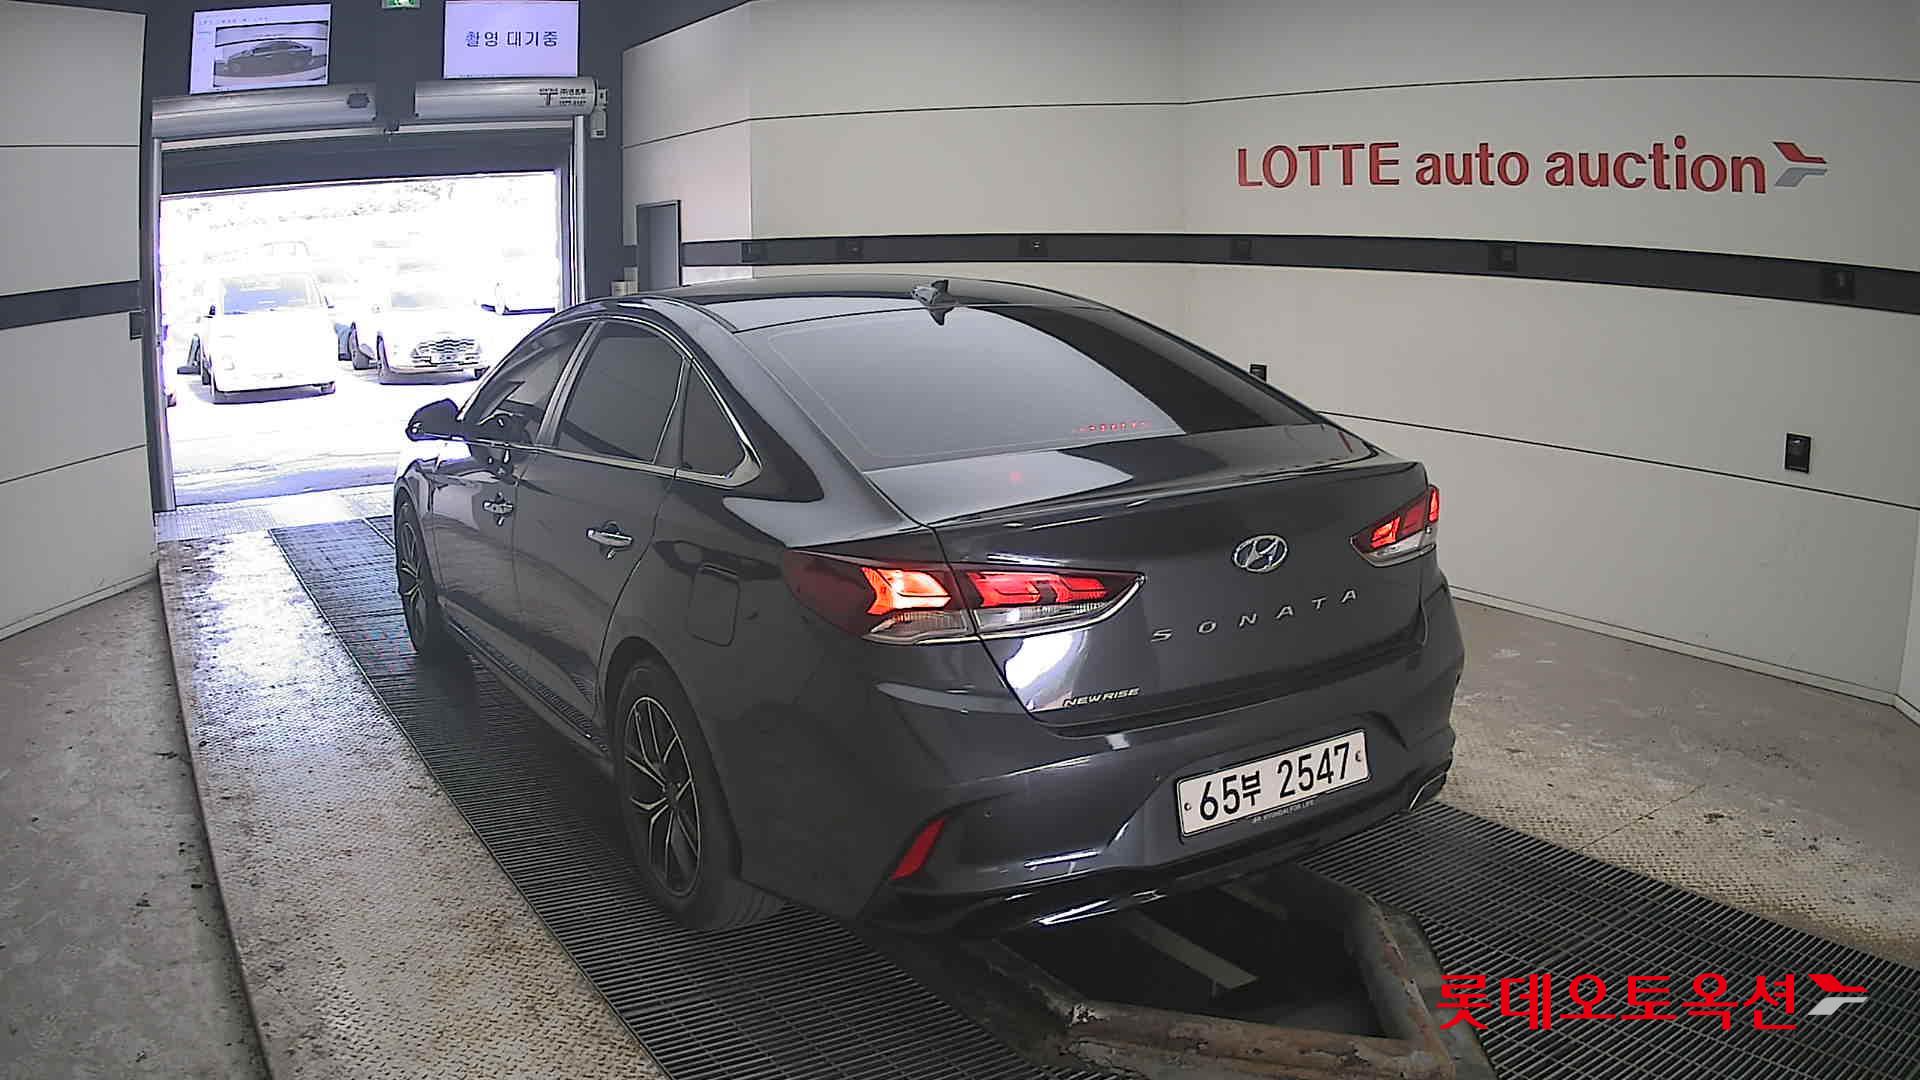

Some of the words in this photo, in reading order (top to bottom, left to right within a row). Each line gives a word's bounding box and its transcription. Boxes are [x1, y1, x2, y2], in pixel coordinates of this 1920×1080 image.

[506, 31, 559, 48] 대기중
[1238, 143, 1400, 188] LOTTE
[1416, 144, 1529, 186] auto
[1545, 135, 1766, 193] auction
[1151, 588, 1357, 642] SONATA
[1199, 770, 1262, 821] 65부
[1276, 741, 1351, 799] 2547
